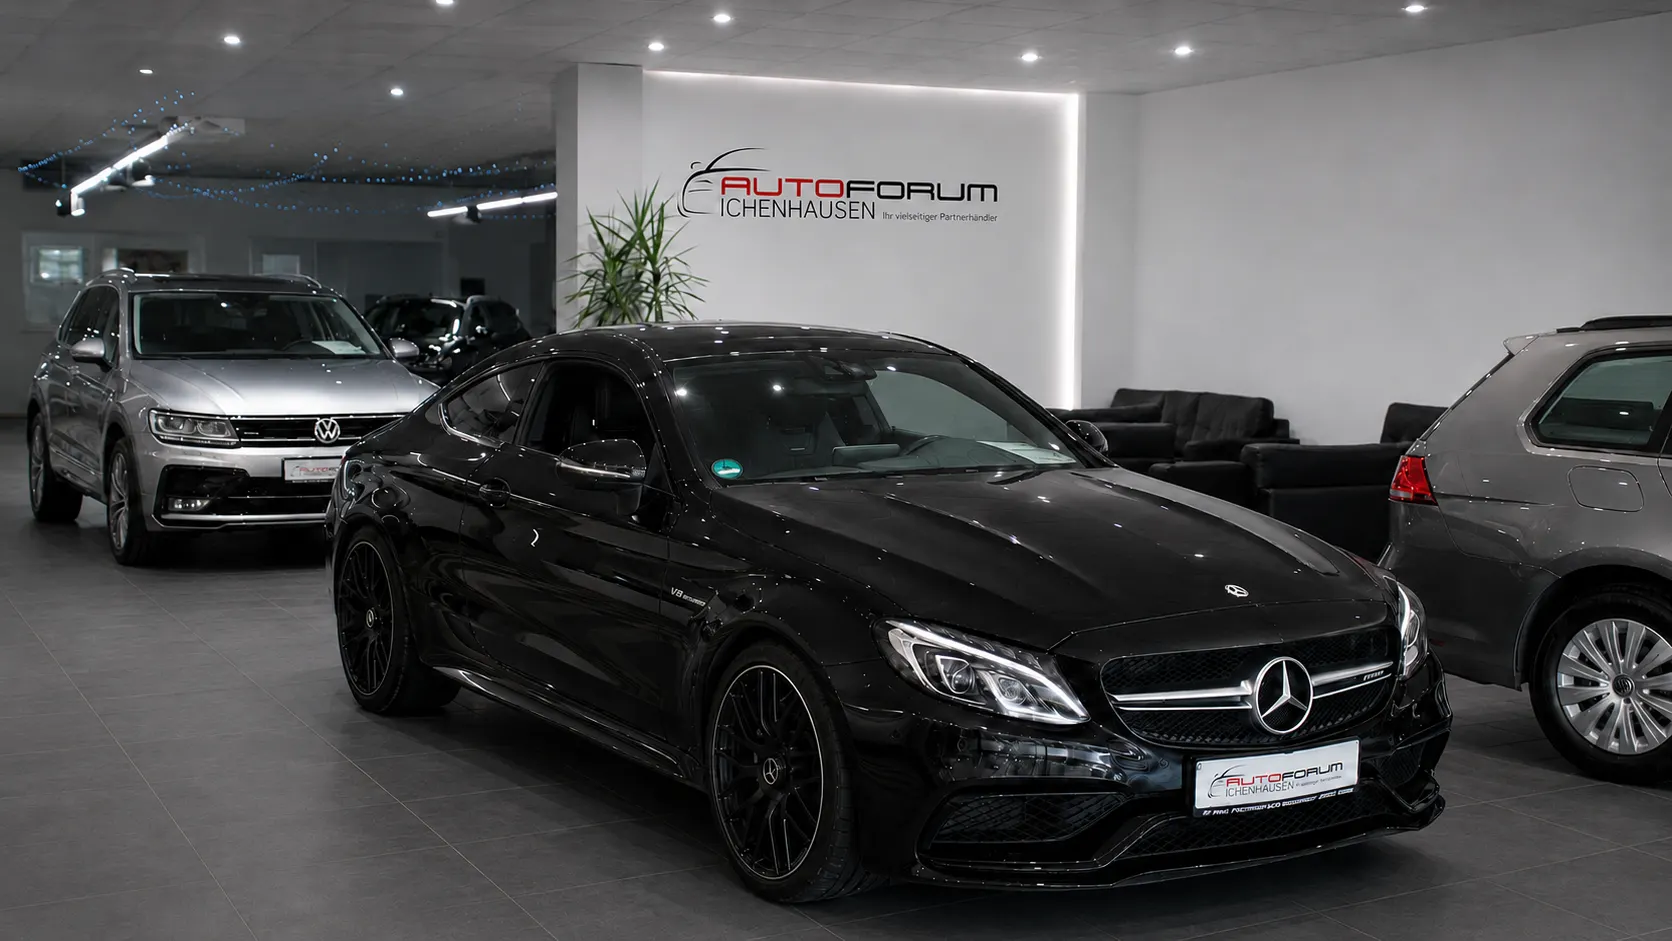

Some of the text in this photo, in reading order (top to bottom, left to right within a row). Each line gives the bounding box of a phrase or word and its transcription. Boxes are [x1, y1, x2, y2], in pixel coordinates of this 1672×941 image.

[721, 177, 998, 202] AUTOFORUM
[720, 198, 876, 220] ICHENHAUSEN
[882, 211, 998, 223] Ihr vielseitiger Partnerhändler
[1226, 762, 1343, 787] AUTOFORUM
[1225, 781, 1294, 798] ICHENHAUSEN
